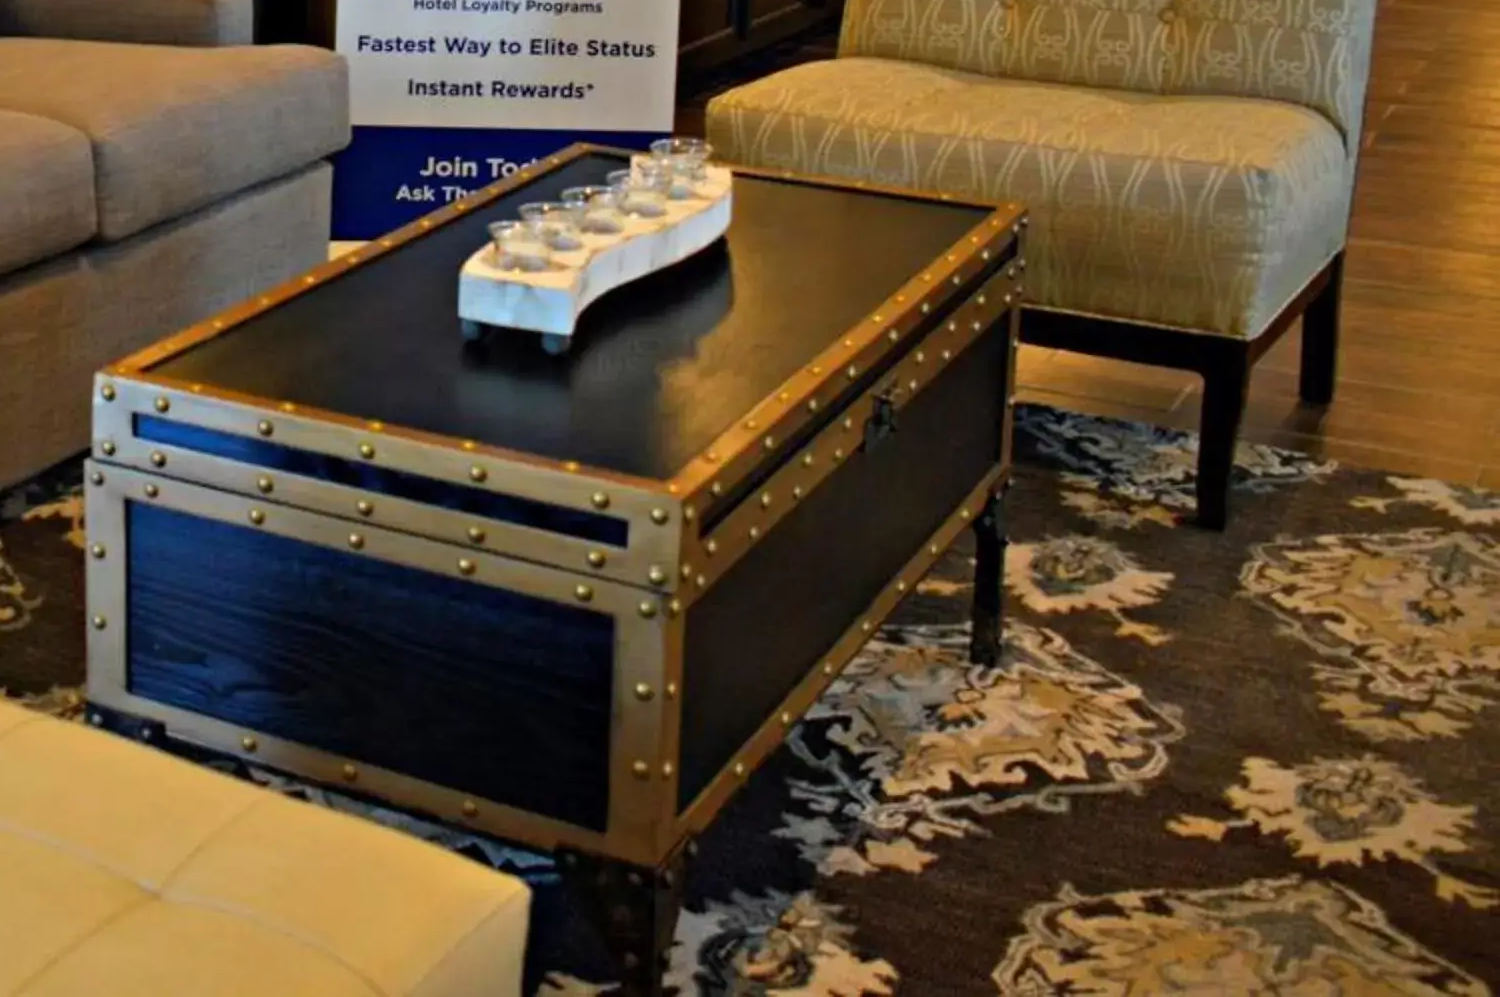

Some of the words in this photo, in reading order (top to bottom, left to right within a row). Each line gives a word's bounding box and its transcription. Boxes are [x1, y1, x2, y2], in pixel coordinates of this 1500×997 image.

[525, 0, 604, 15] Programs
[357, 35, 436, 53] Fastest
[444, 37, 492, 58] Way
[499, 39, 522, 55] to
[530, 38, 579, 56] Elite
[586, 39, 656, 58] Status
[408, 79, 483, 97] Instant
[419, 156, 478, 177] Join
[486, 157, 538, 178] To
[395, 184, 436, 202] Ask
